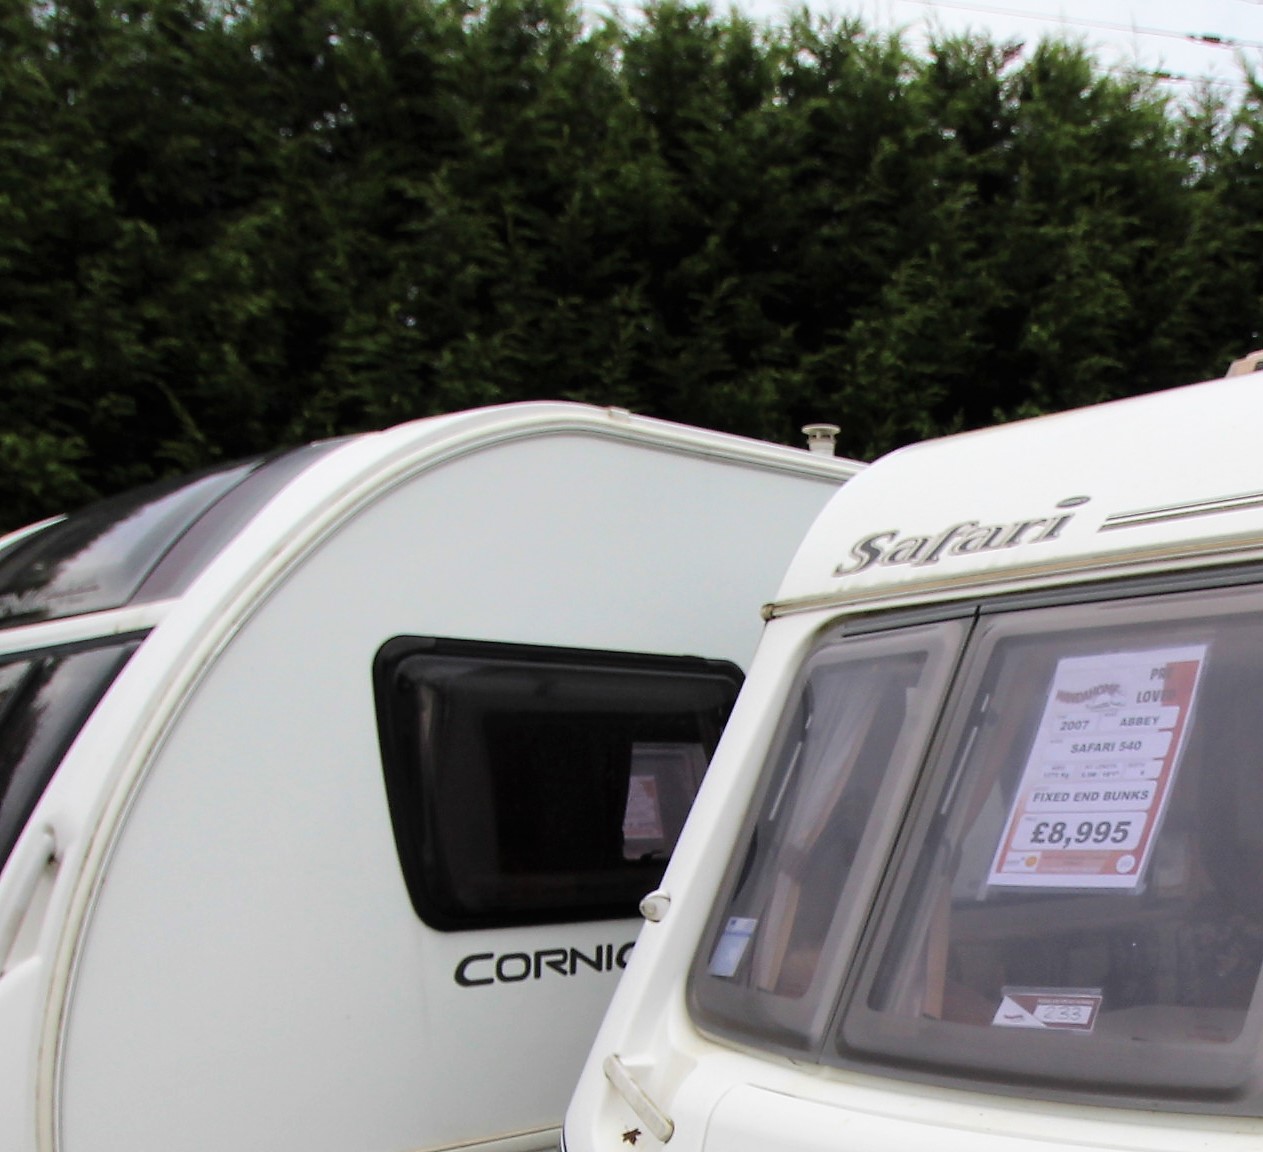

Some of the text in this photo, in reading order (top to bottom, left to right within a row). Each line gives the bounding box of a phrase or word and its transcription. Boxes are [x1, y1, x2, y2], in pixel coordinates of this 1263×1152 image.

[832, 495, 1091, 577] Safari
[1060, 719, 1090, 731] 2007
[1119, 715, 1160, 727] ABBEY
[1070, 740, 1142, 754] SAFARI 540
[1033, 789, 1150, 803] FIXED END BUNKS
[1030, 820, 1132, 849] £8,995
